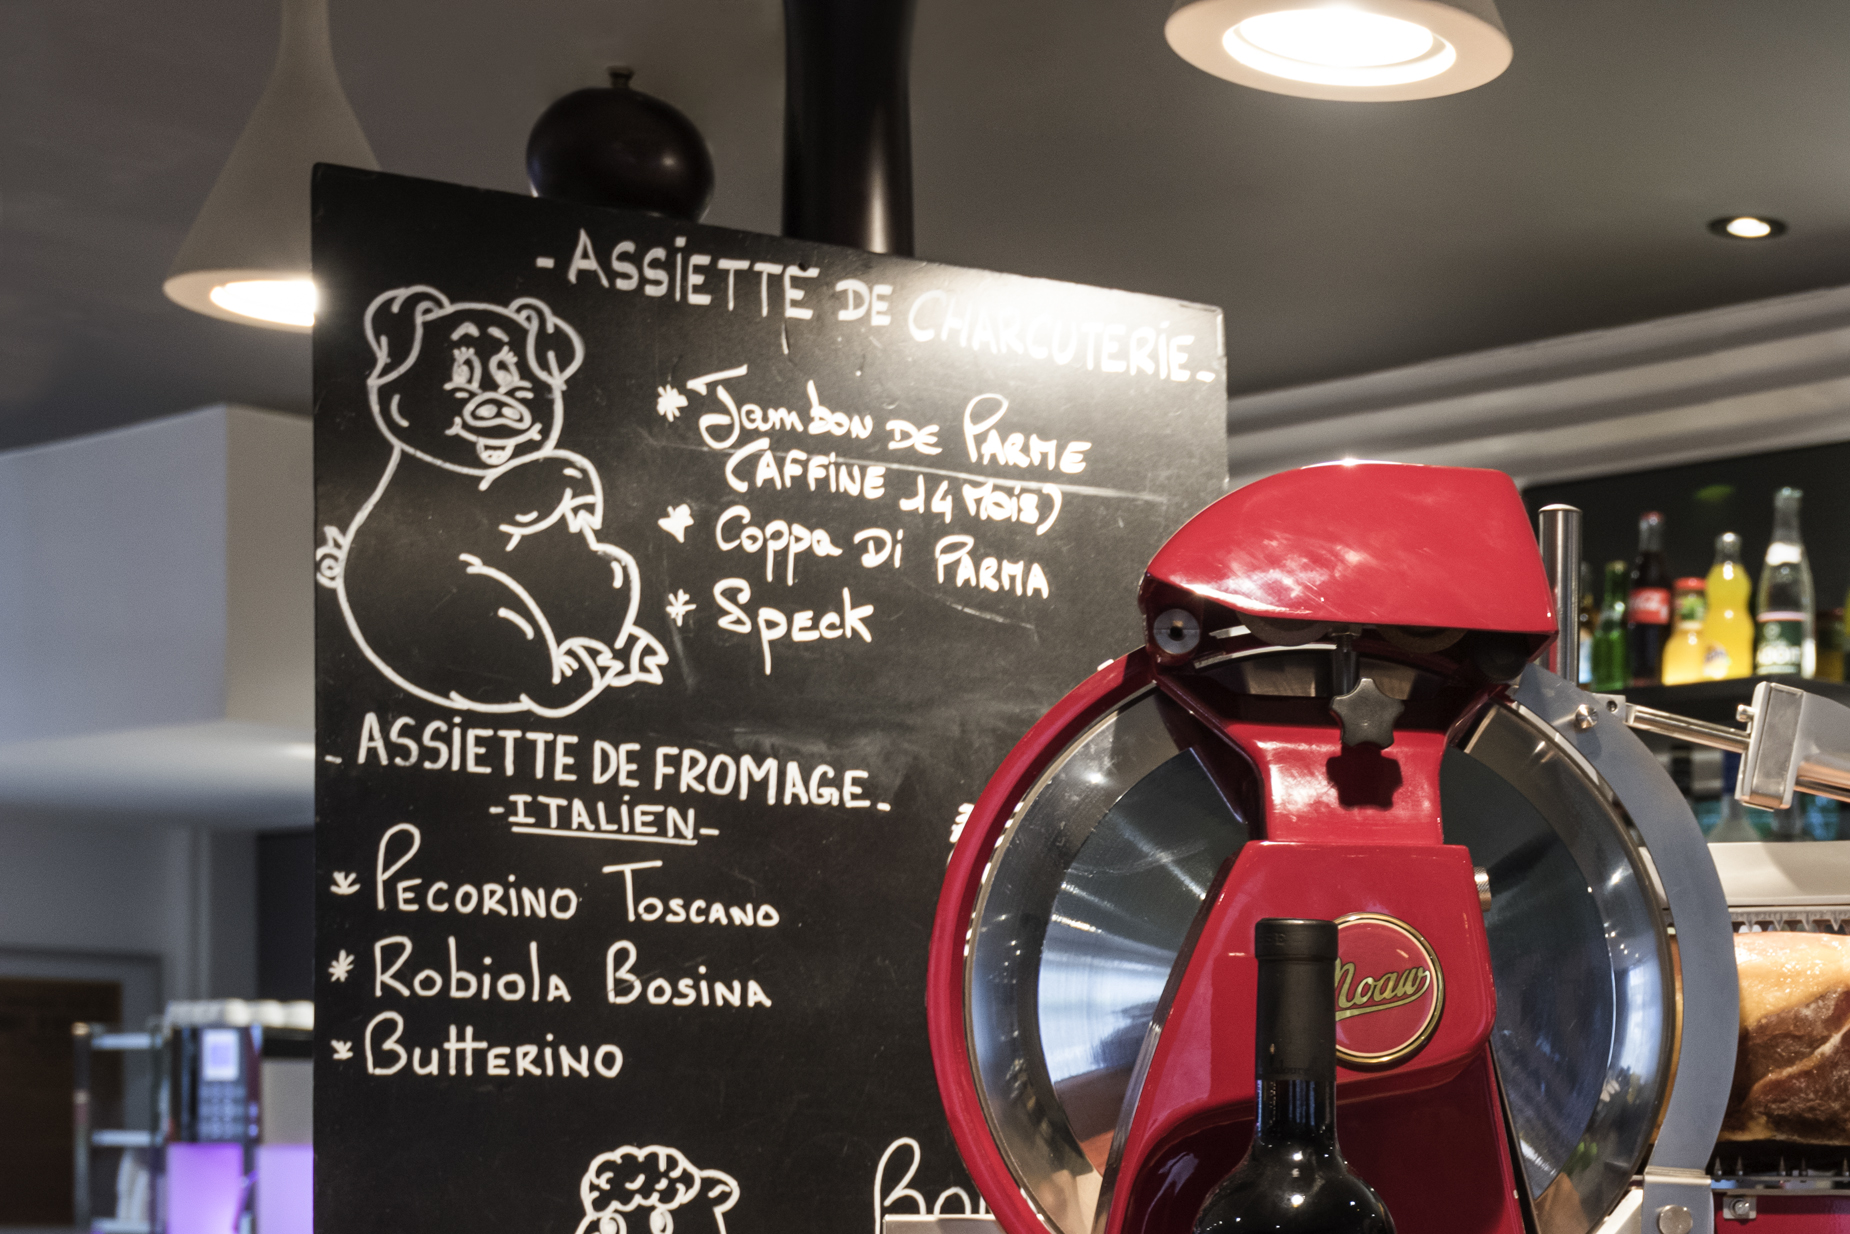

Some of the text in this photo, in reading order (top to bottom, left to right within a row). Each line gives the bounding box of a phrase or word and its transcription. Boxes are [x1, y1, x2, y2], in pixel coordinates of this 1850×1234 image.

[834, 278, 894, 327] DE
[886, 419, 943, 456] DE
[899, 475, 953, 524] 14
[592, 740, 641, 788] DE
